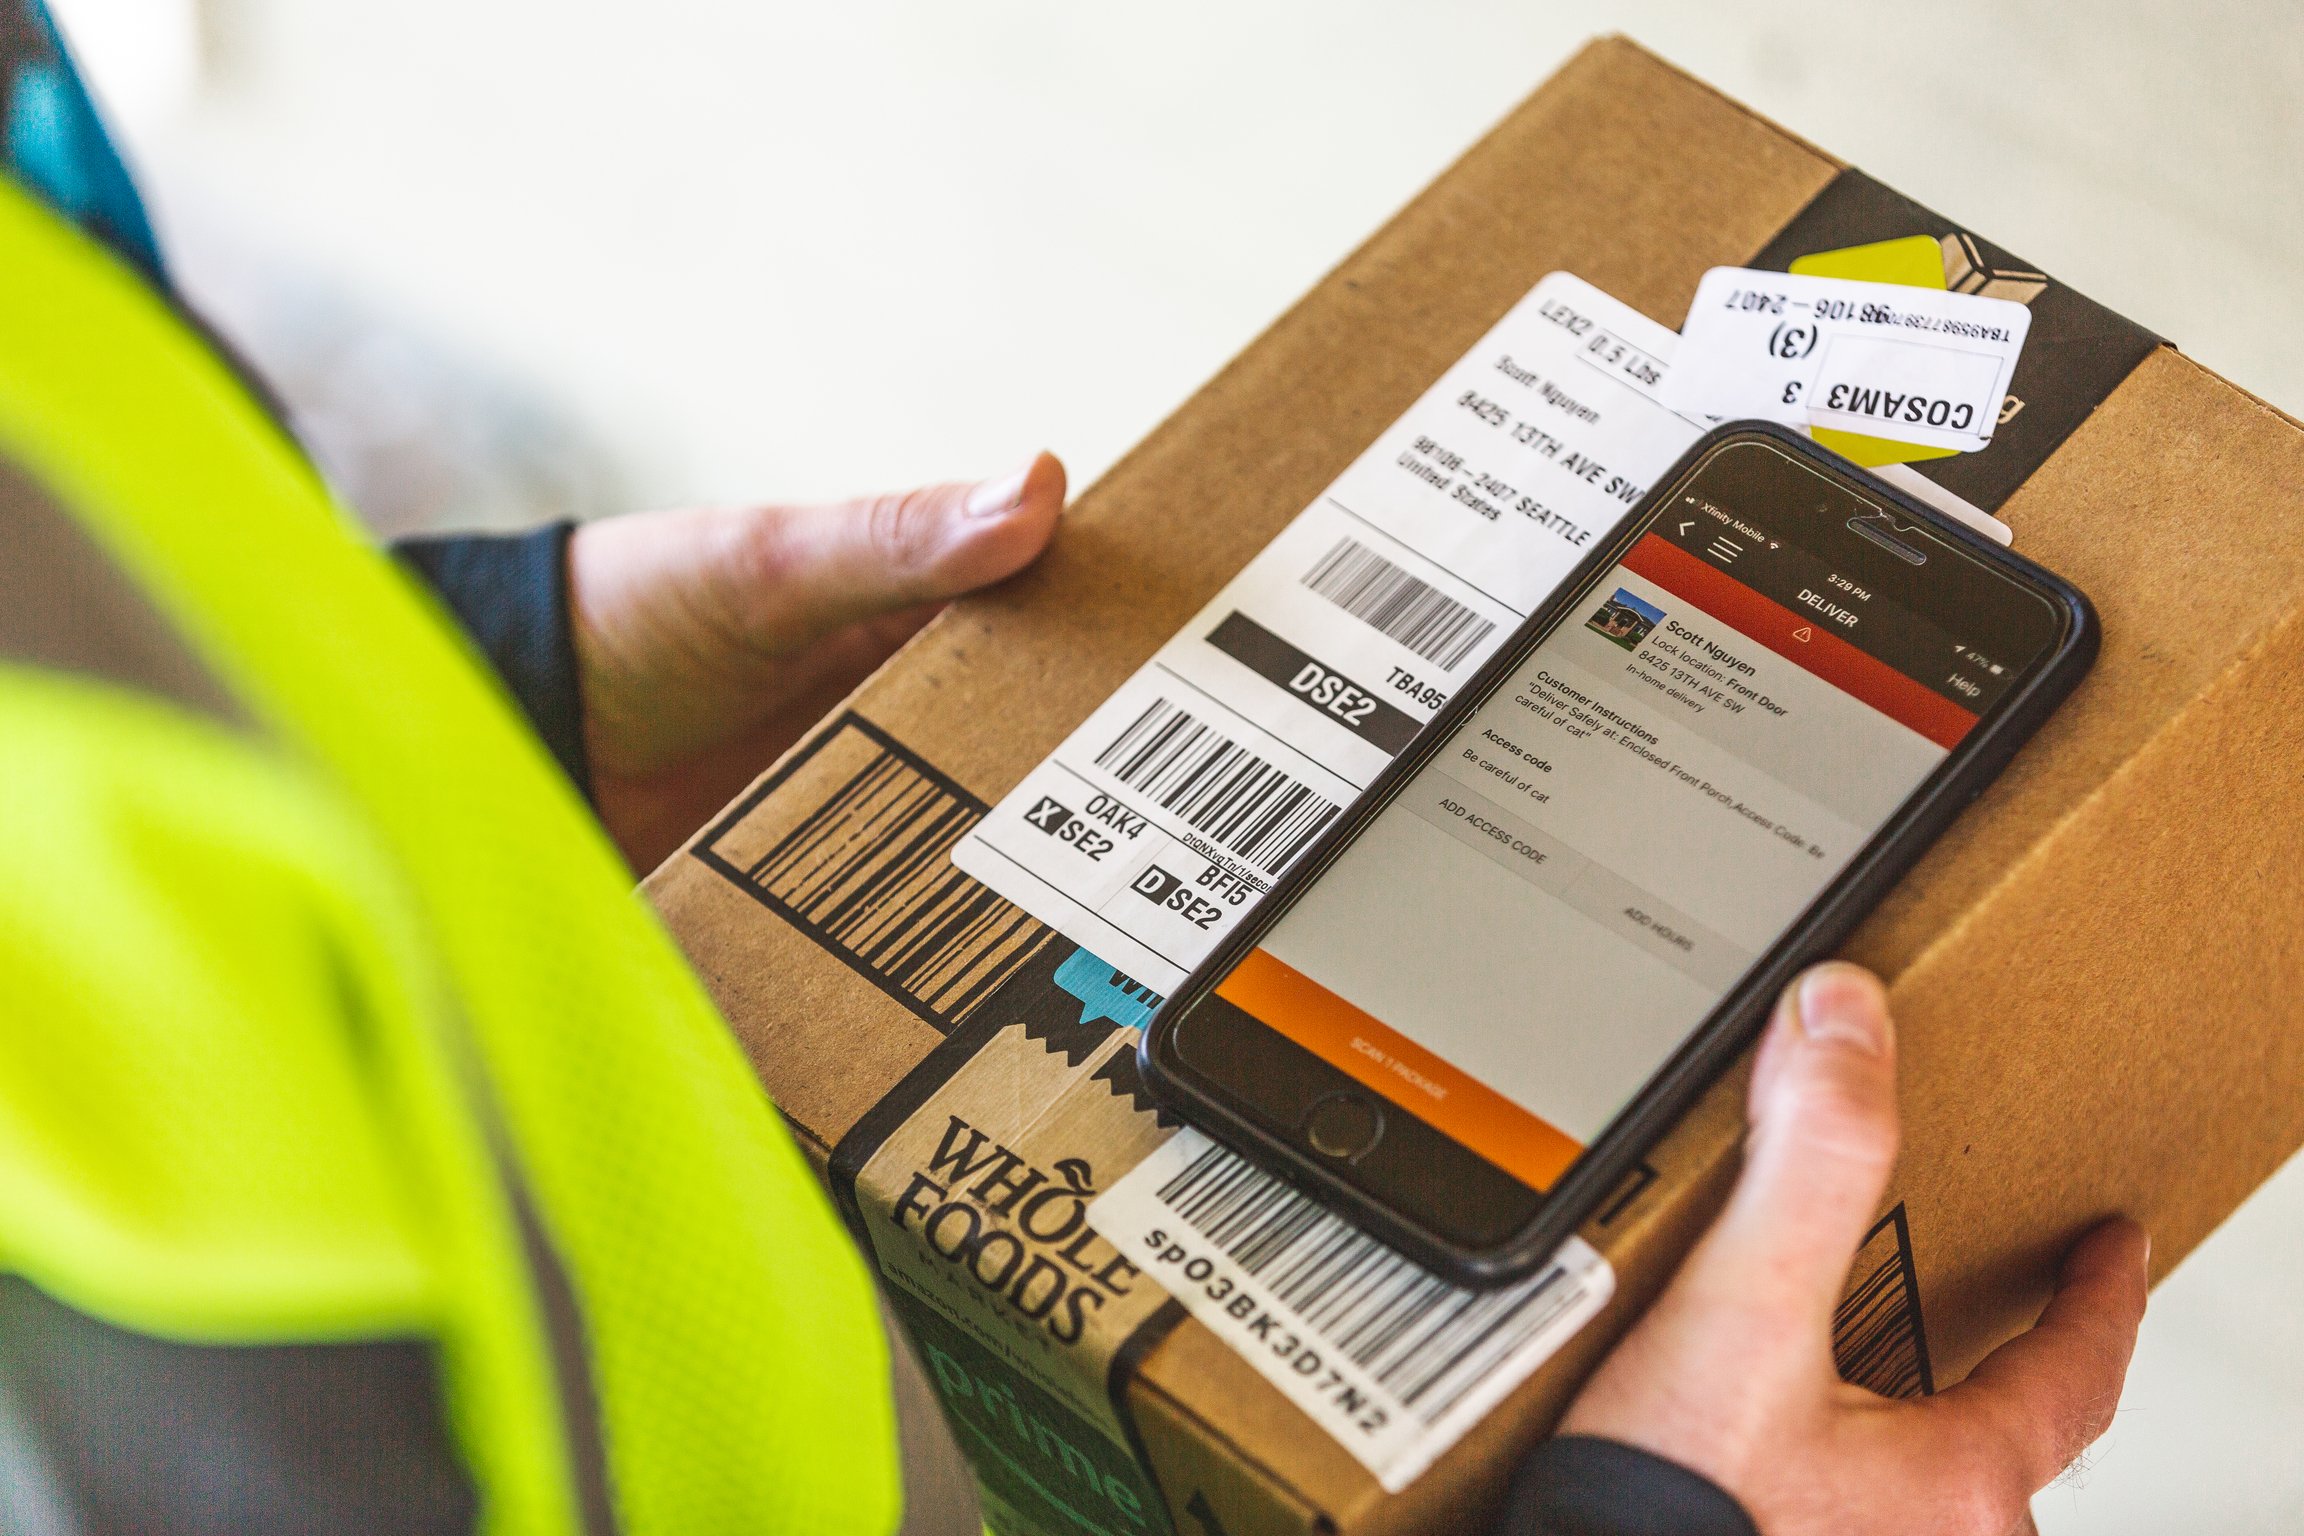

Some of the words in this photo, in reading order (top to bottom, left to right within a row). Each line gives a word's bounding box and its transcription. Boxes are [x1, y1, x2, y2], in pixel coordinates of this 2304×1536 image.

[1588, 335, 1625, 362] 0.5
[1768, 320, 1818, 360] (3)
[1782, 381, 1803, 404] 3
[1827, 383, 1975, 430] COSAM3
[1457, 390, 1511, 428] 8425
[1510, 421, 1564, 459] 13TH
[1560, 452, 1607, 485] AVE
[1396, 450, 1452, 491] United
[1451, 484, 1502, 522] States
[1514, 496, 1592, 547] SEATTLE
[1701, 502, 1732, 526] Xfinity
[1732, 519, 1766, 543] Mobile
[1797, 589, 1859, 628] DELIVER
[1827, 573, 1853, 592] 3:29
[1852, 587, 1872, 602] PM
[1665, 620, 1704, 648] Scott
[1704, 642, 1757, 678] Nguyen
[1289, 662, 1377, 727] DSE2
[1385, 665, 1449, 712] TBA95
[1625, 663, 1667, 692] In-home
[1665, 686, 1706, 714] delivery
[1638, 649, 1670, 673] 8425
[1670, 667, 1700, 690] 13TH
[1699, 684, 1725, 704] AVE
[1723, 698, 1747, 715] SW
[1651, 636, 1678, 656] Lock
[1678, 647, 1727, 683] location:
[1726, 678, 1757, 702] Front
[1756, 697, 1789, 718] Door
[1948, 673, 1982, 698] Help
[1514, 694, 1554, 722] careful
[1552, 714, 1569, 730] of
[1537, 670, 1592, 705] Customer
[1591, 700, 1659, 746] Instructions
[1481, 728, 1524, 757] Access
[1522, 751, 1553, 773] code
[1567, 706, 1603, 733] Safely
[1602, 727, 1620, 741] at:
[1618, 736, 1670, 770] Enclosed
[1669, 763, 1702, 789] Front
[1462, 747, 1480, 762] Be
[1478, 756, 1519, 786] careful
[1516, 778, 1533, 794] of
[1530, 787, 1551, 804] cat
[1084, 795, 1148, 841] OAK4
[1438, 797, 1467, 818] ADD
[1464, 813, 1513, 845] ACCESS
[1511, 839, 1547, 866] CODE
[1623, 906, 1653, 924] ADD
[927, 1115, 1141, 1298] WHOLE
[891, 1171, 1106, 1346] FOODS
